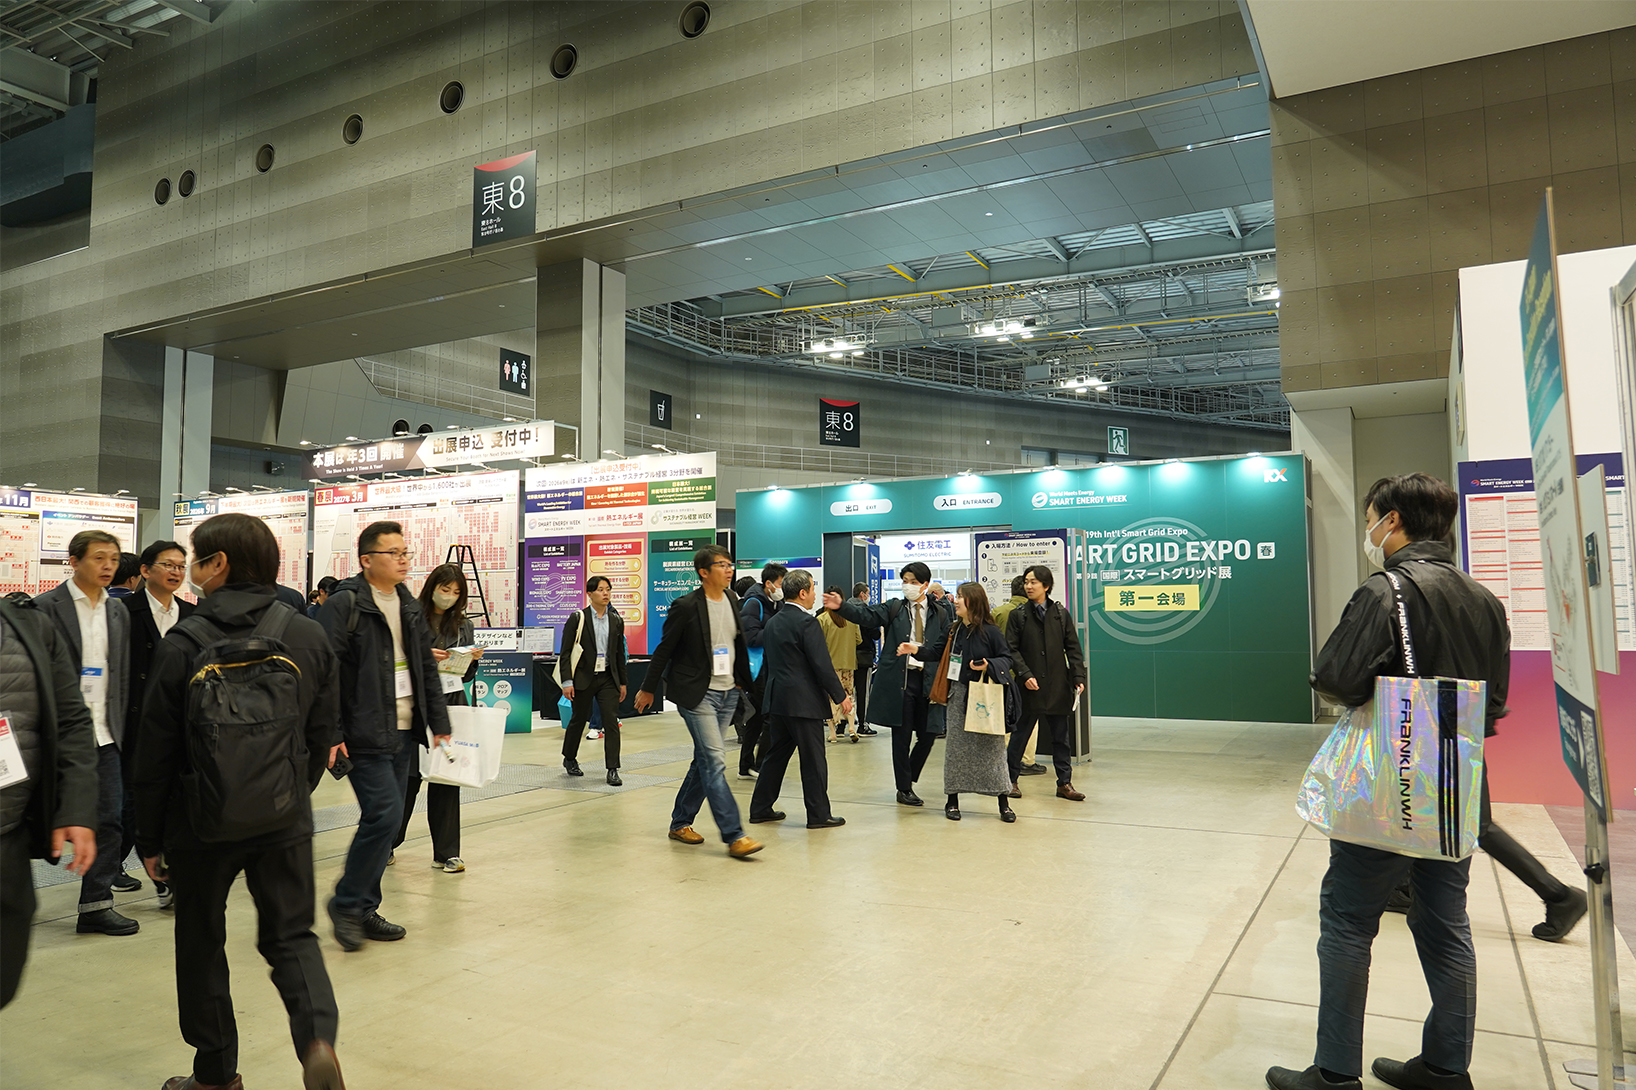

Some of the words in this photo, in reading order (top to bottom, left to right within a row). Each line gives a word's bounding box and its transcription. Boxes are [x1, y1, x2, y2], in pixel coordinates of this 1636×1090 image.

[481, 175, 526, 216] 東8
[825, 410, 854, 432] 東8
[433, 433, 484, 455] 出展申込
[491, 427, 539, 449] 受付中!
[312, 451, 345, 468] 本展は
[346, 446, 378, 465] 年3回
[1263, 468, 1288, 483] RX
[351, 491, 364, 503] 3月
[1078, 489, 1095, 497] Energy
[0, 493, 29, 507] 11月
[941, 498, 957, 508] 入口
[962, 498, 995, 506] ENTRANCE
[1049, 497, 1074, 506] SMART
[1076, 496, 1105, 505] ENERGY
[1106, 495, 1127, 503] WEEK
[205, 503, 216, 514] 9月
[845, 504, 859, 513] 出口
[606, 512, 644, 522] 熱エネルギー展
[697, 512, 713, 520] WEEK
[538, 520, 552, 528] SMART
[1086, 530, 1102, 539] 19th
[1104, 530, 1121, 538] Int'l
[1121, 528, 1147, 538] Smart
[1148, 528, 1166, 536] Grid
[1167, 527, 1188, 537] Expo
[917, 540, 951, 550] 住友電工
[1260, 545, 1273, 557] 春
[1067, 544, 1117, 565] ART
[1122, 542, 1179, 563] GRID
[1186, 539, 1252, 561] EXPO
[1123, 565, 1232, 581] スマートグリッド展
[1118, 590, 1186, 607] 第一会場
